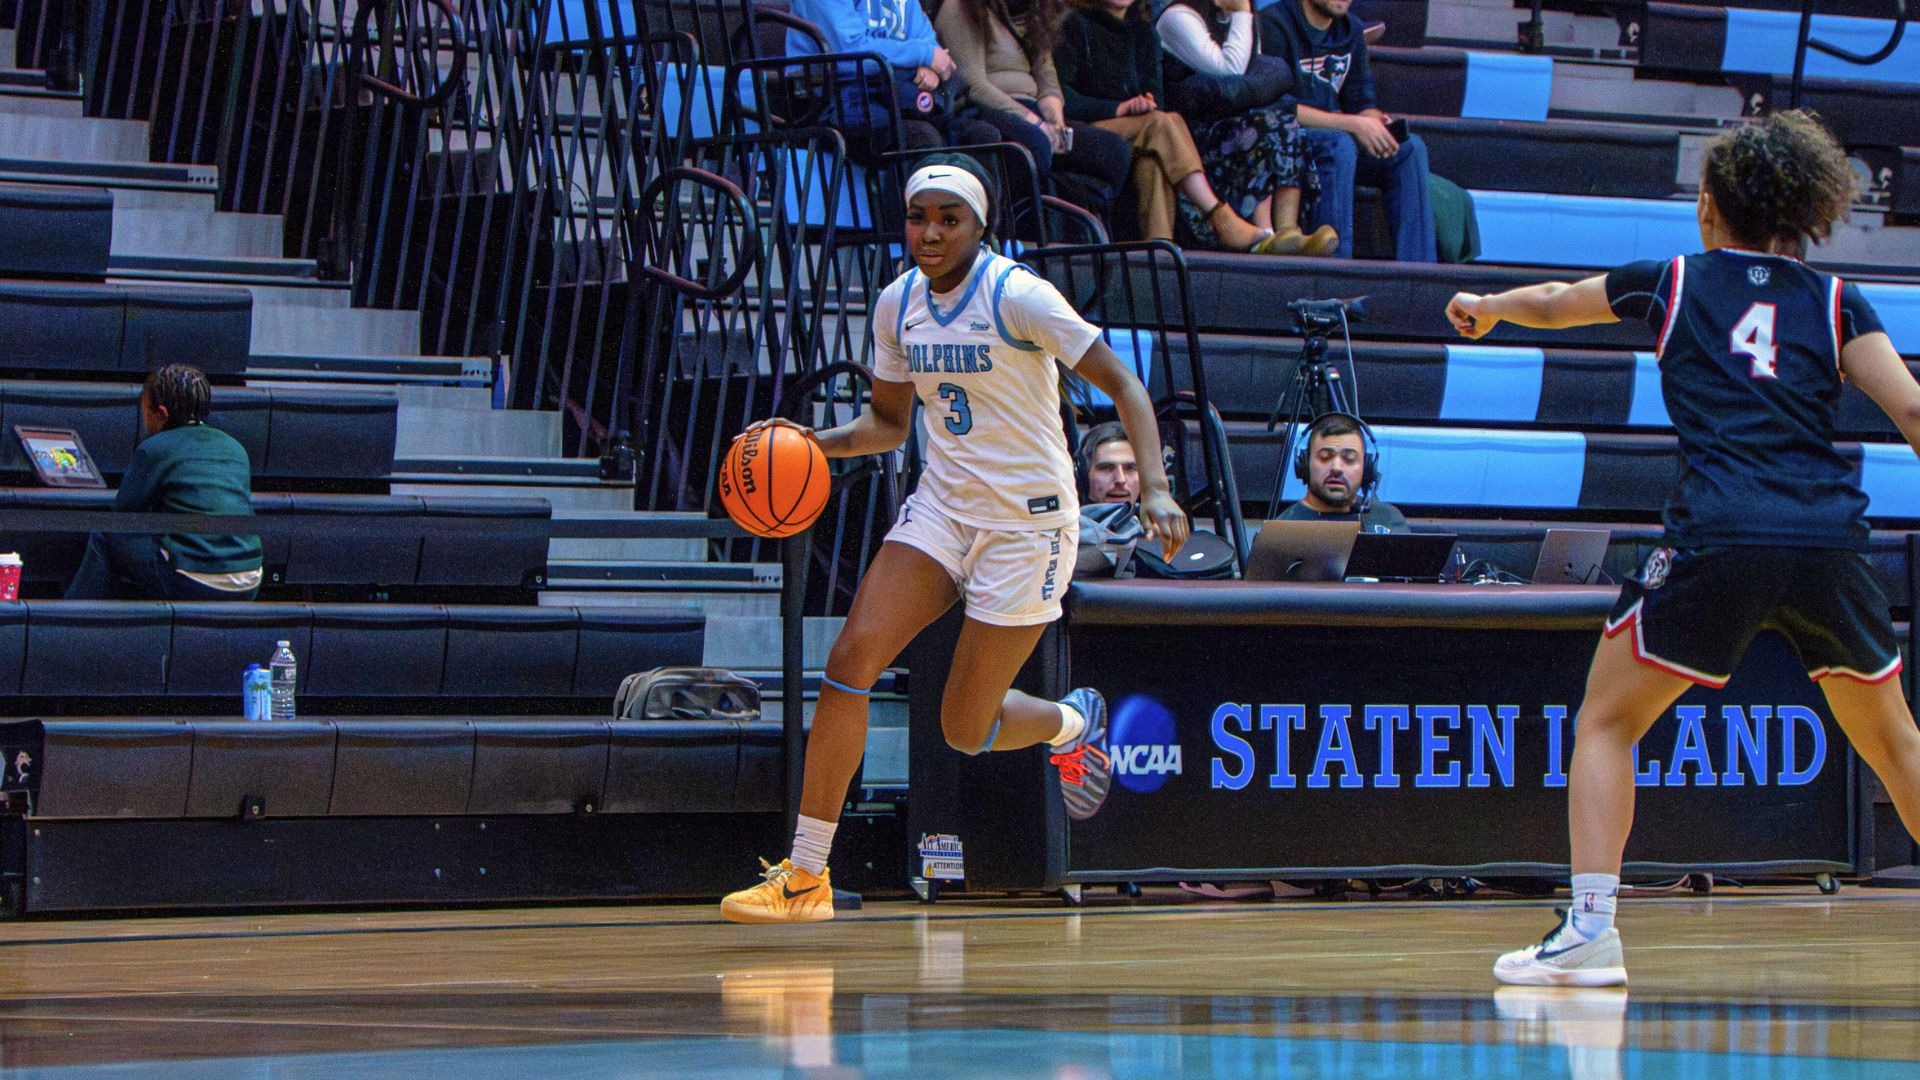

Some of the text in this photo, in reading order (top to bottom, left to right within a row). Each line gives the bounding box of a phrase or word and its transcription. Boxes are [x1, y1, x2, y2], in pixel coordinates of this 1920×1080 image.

[1730, 301, 1778, 379] 4
[938, 382, 973, 435] 3
[1109, 745, 1182, 775] NCAA
[1211, 702, 1827, 790] STATEN ILAND
